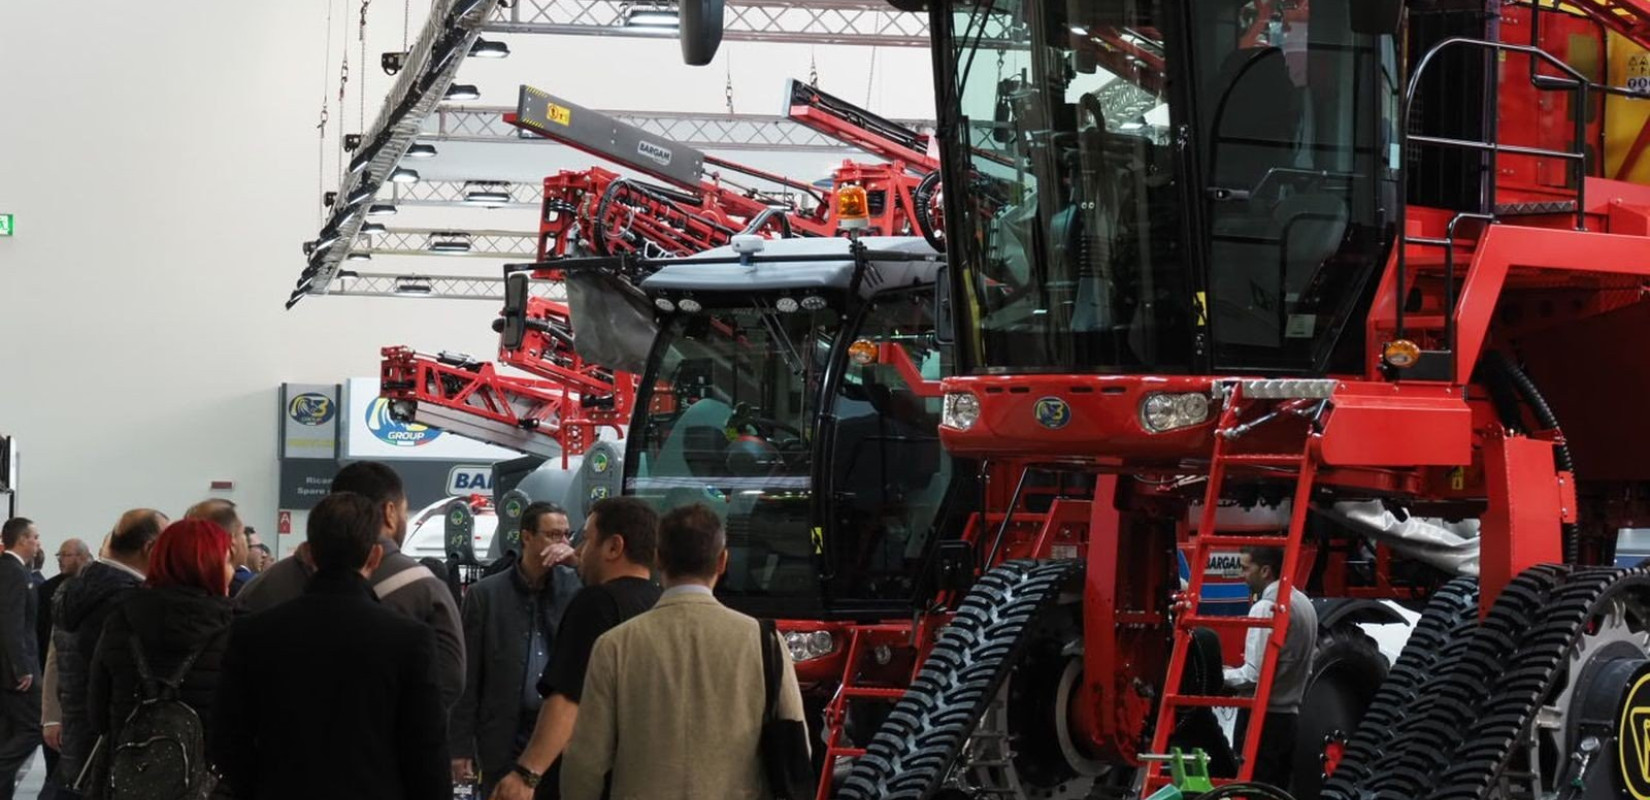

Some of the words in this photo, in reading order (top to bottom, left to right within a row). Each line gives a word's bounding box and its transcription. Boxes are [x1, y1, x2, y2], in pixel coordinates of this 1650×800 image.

[640, 143, 670, 159] BARGAM
[387, 431, 425, 440] GROUP
[454, 473, 494, 489] BA
[297, 487, 326, 496] Spare
[280, 512, 290, 524] A
